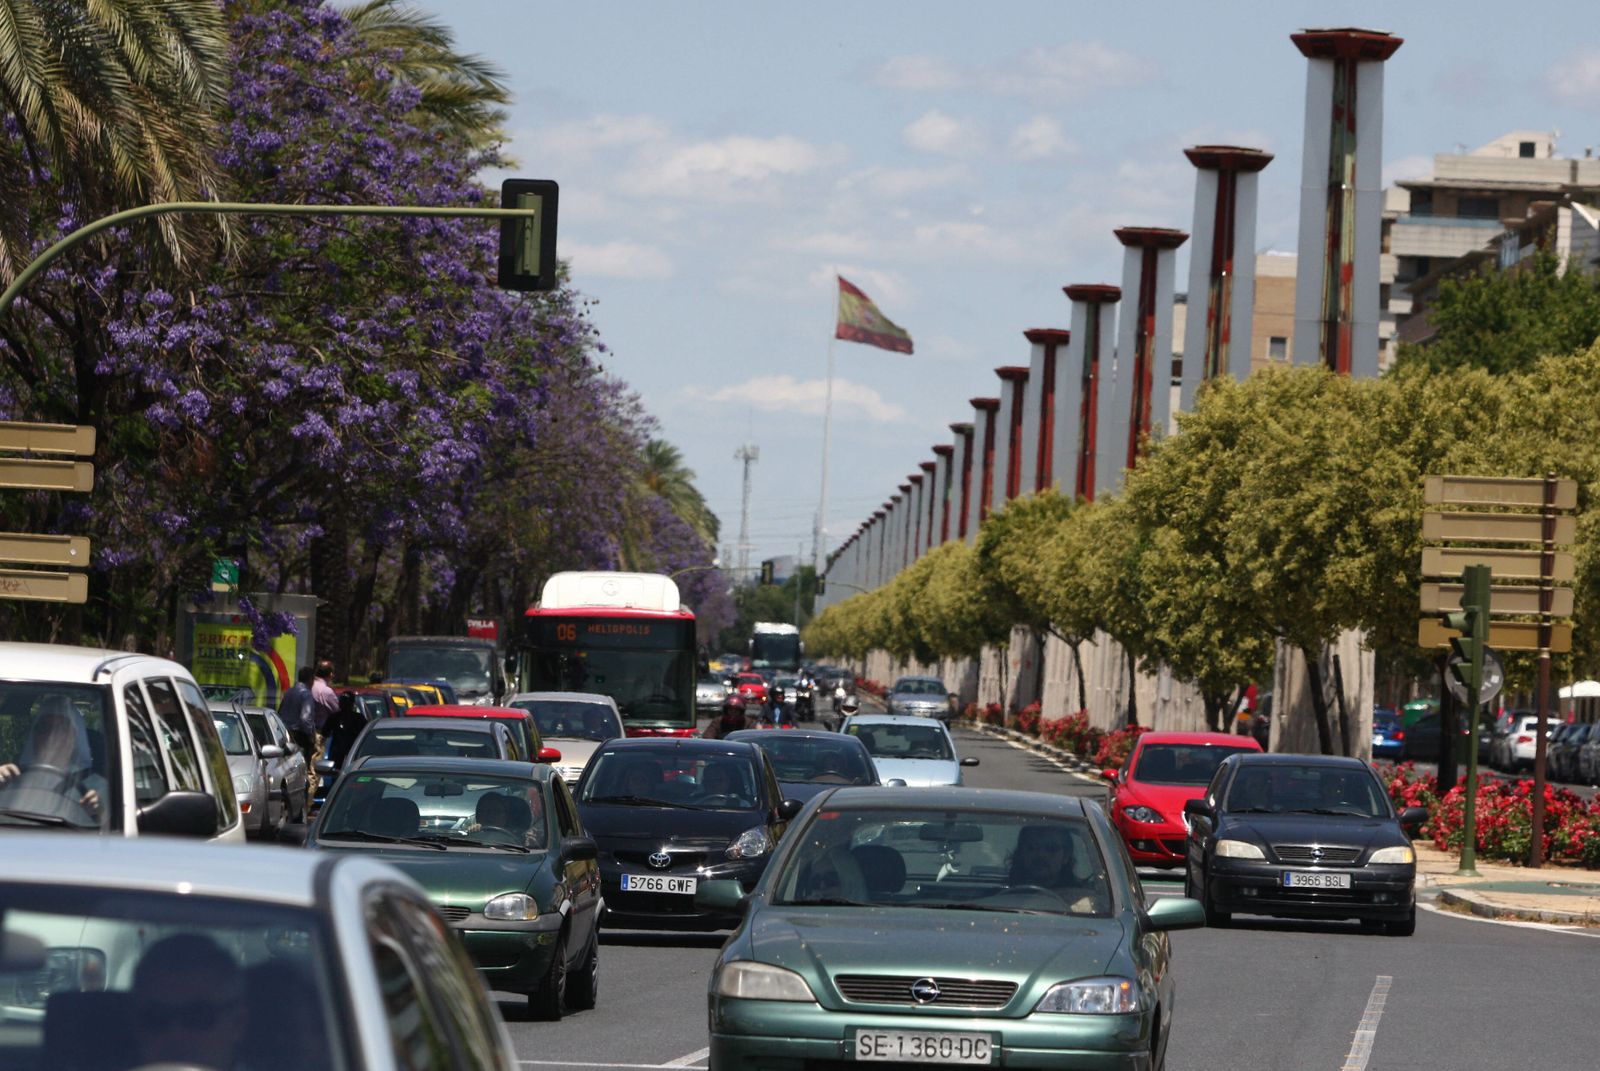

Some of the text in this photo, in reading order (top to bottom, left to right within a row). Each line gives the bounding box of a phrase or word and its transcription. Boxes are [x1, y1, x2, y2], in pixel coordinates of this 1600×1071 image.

[556, 623, 651, 641] 06 HELIOPOLIS
[630, 876, 693, 893] 5766 GWF
[1293, 874, 1345, 887] 3966 BSL
